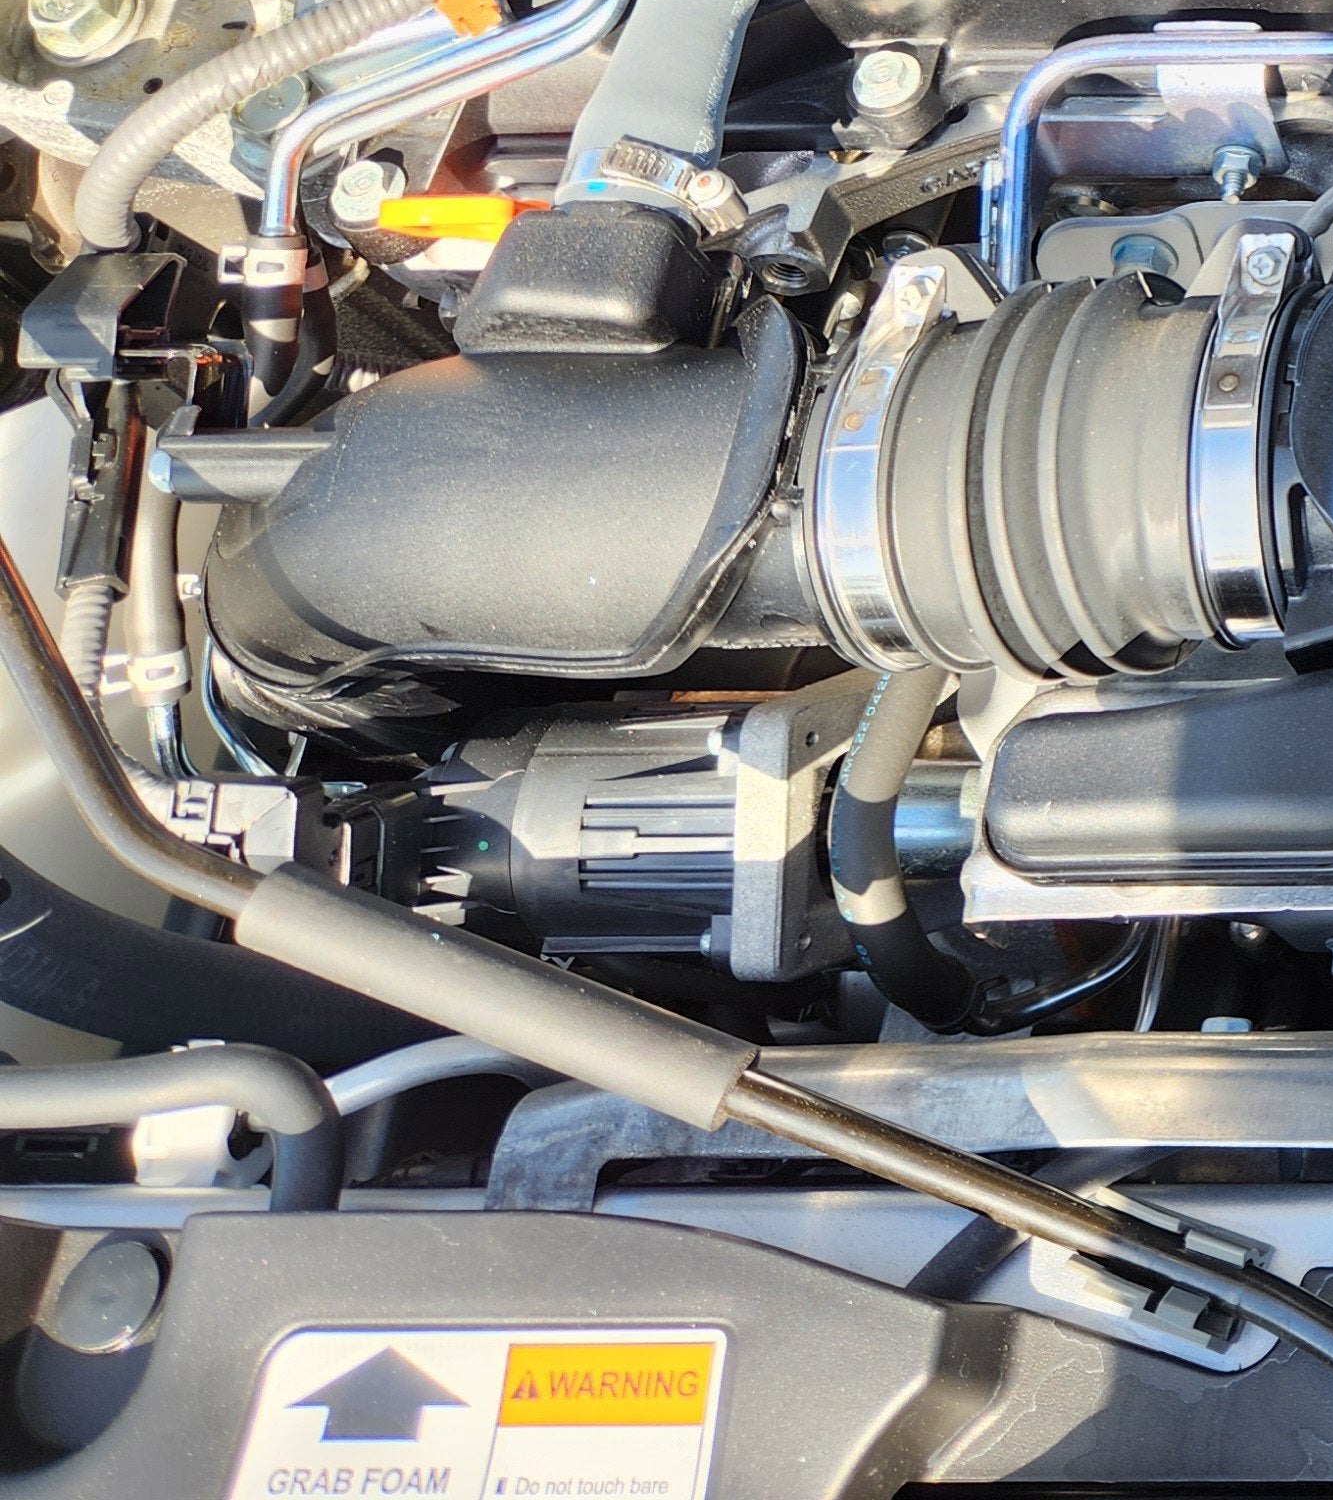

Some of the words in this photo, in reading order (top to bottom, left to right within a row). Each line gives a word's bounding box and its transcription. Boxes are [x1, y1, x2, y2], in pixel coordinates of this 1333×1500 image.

[548, 1371, 699, 1398] WARNING
[268, 1468, 354, 1495] GRAB
[361, 1468, 450, 1495] FOAM
[514, 1478, 539, 1495] Do
[544, 1479, 573, 1495] not
[577, 1478, 626, 1495] touch
[630, 1478, 669, 1495] bare
